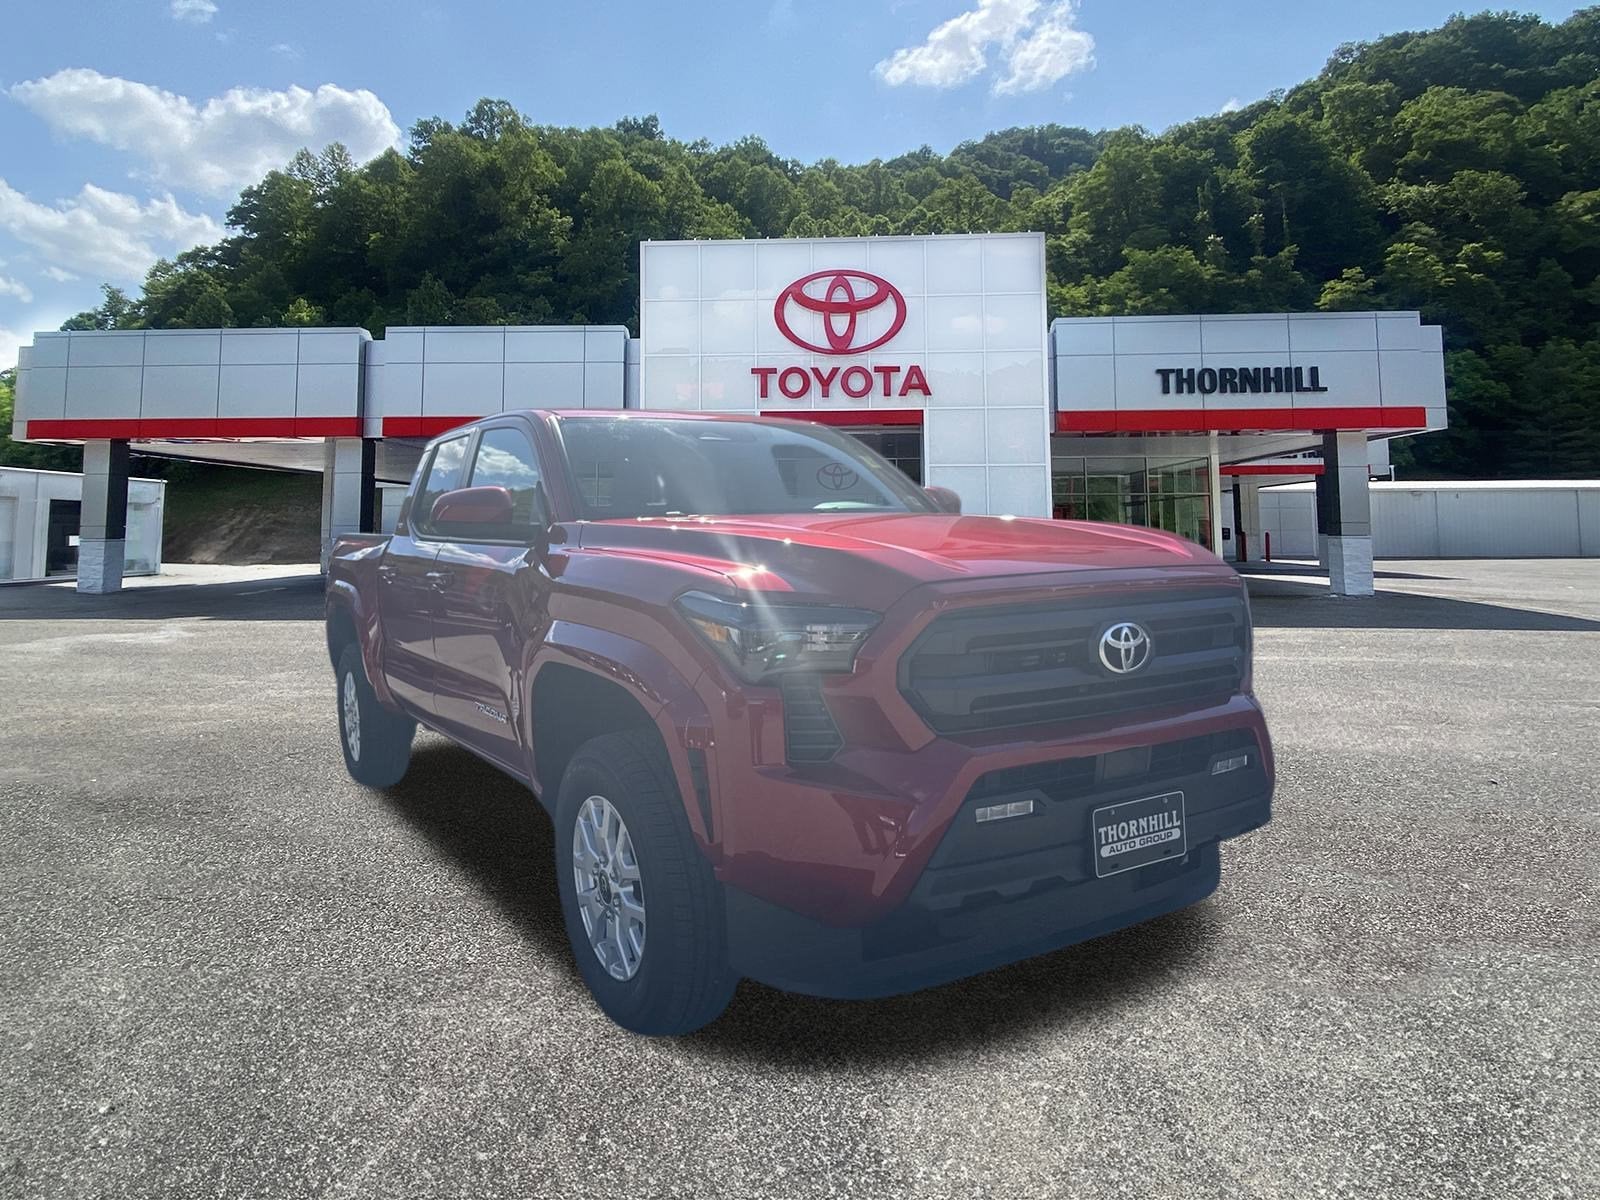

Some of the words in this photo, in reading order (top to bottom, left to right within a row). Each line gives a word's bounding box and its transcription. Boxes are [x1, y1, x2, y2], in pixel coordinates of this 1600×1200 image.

[751, 365, 932, 398] TOYOTA
[1156, 366, 1327, 394] THORNHILL
[1098, 810, 1181, 844] THORNHILL
[1108, 840, 1137, 854] AUTO
[1139, 831, 1173, 847] GROUP
